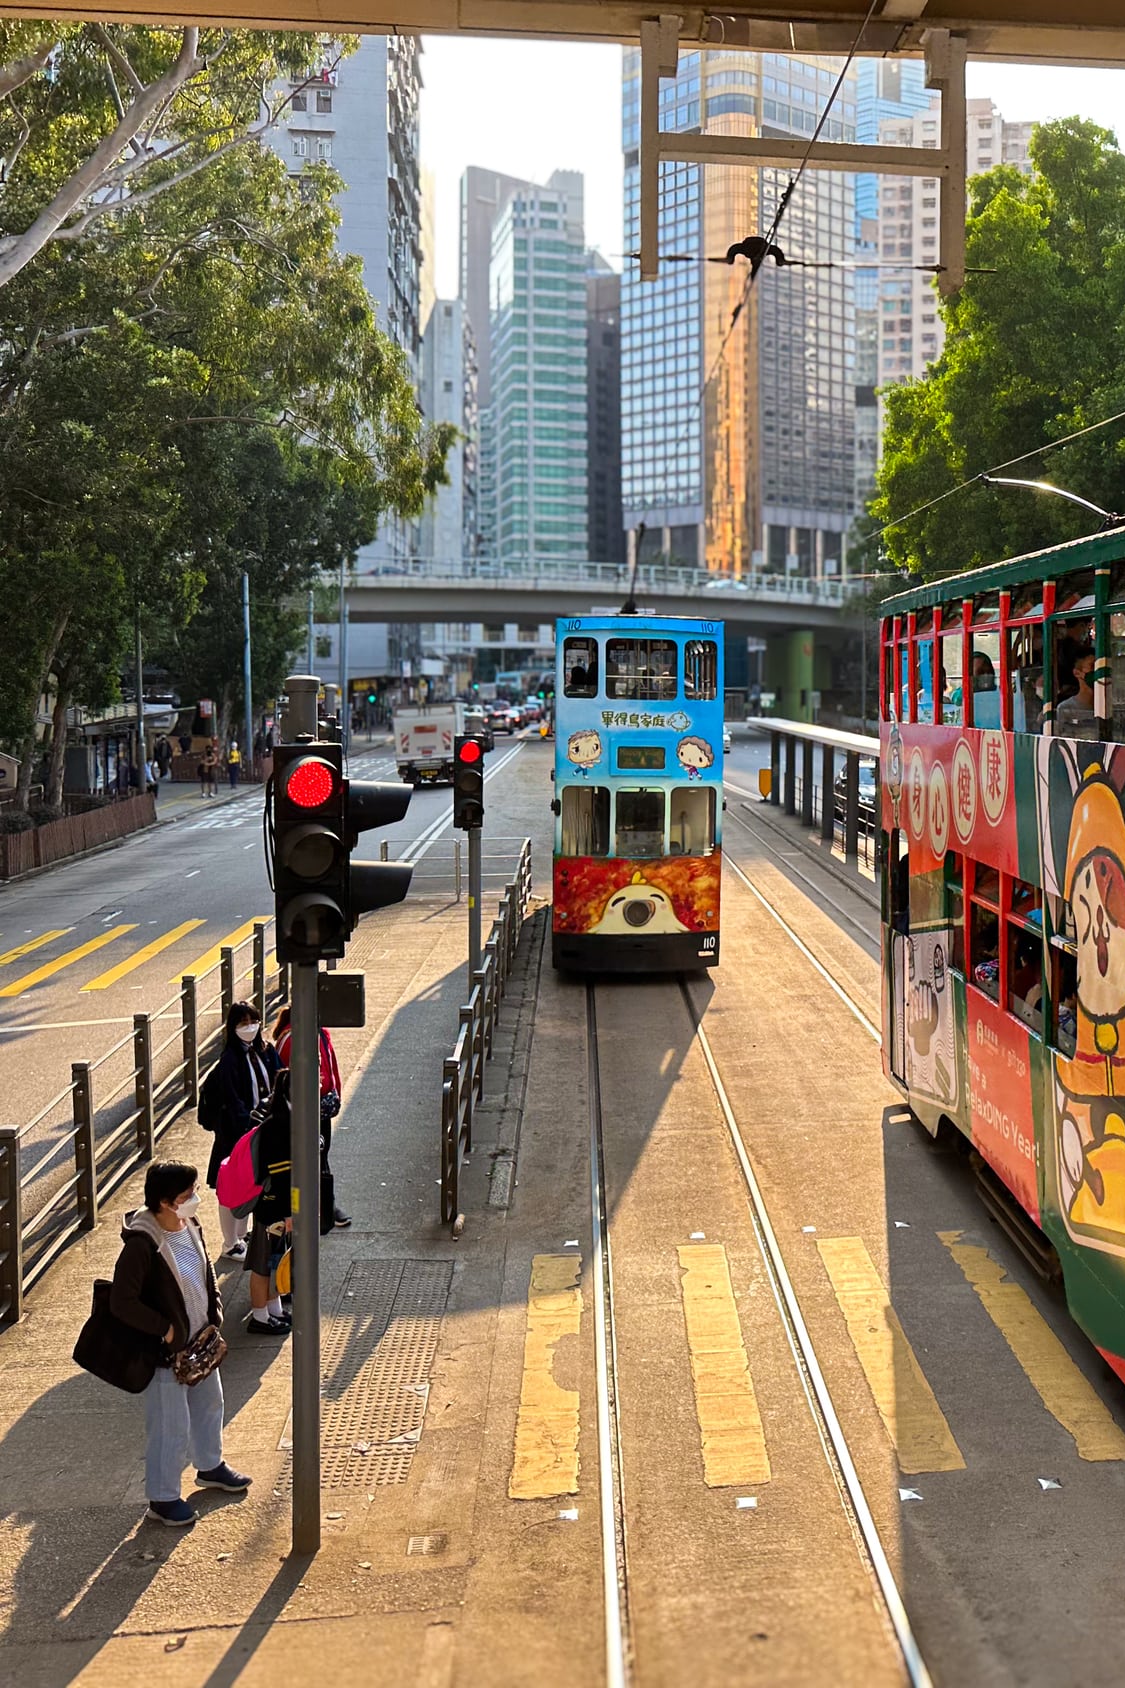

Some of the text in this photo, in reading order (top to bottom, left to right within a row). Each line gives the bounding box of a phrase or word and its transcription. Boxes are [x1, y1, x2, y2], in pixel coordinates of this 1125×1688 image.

[567, 619, 582, 631] 110
[701, 623, 714, 633] 110
[703, 936, 716, 949] 110
[963, 1043, 987, 1091] Have a
[965, 1081, 1041, 1168] RelaxDING Year!
